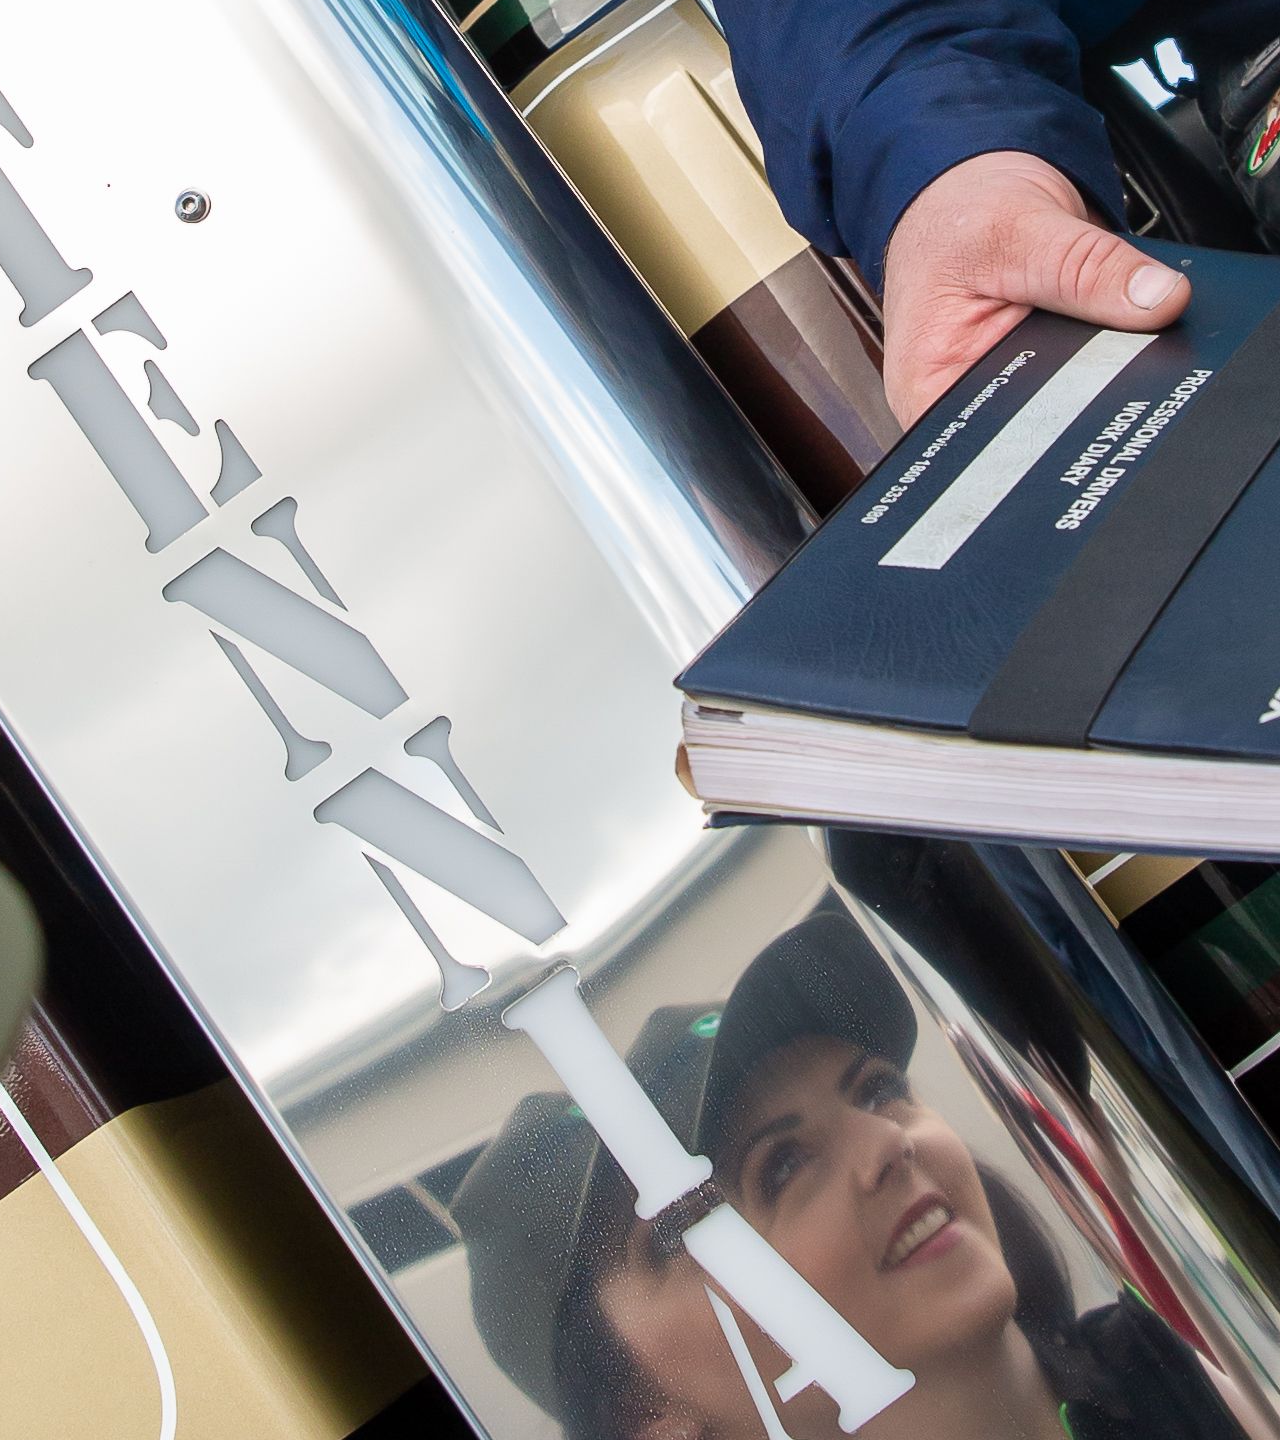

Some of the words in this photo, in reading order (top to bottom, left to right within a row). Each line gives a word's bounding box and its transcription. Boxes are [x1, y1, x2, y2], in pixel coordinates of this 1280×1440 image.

[999, 350, 1036, 377] Caltex
[957, 377, 1009, 420] Customer
[1110, 369, 1214, 465] PROFESSIONAL
[921, 421, 967, 458] Service
[1095, 401, 1151, 442] WORK
[898, 459, 931, 484] 1800
[1059, 443, 1113, 486] DIARY
[879, 484, 908, 504] 333
[1054, 467, 1127, 530] DRIVERS
